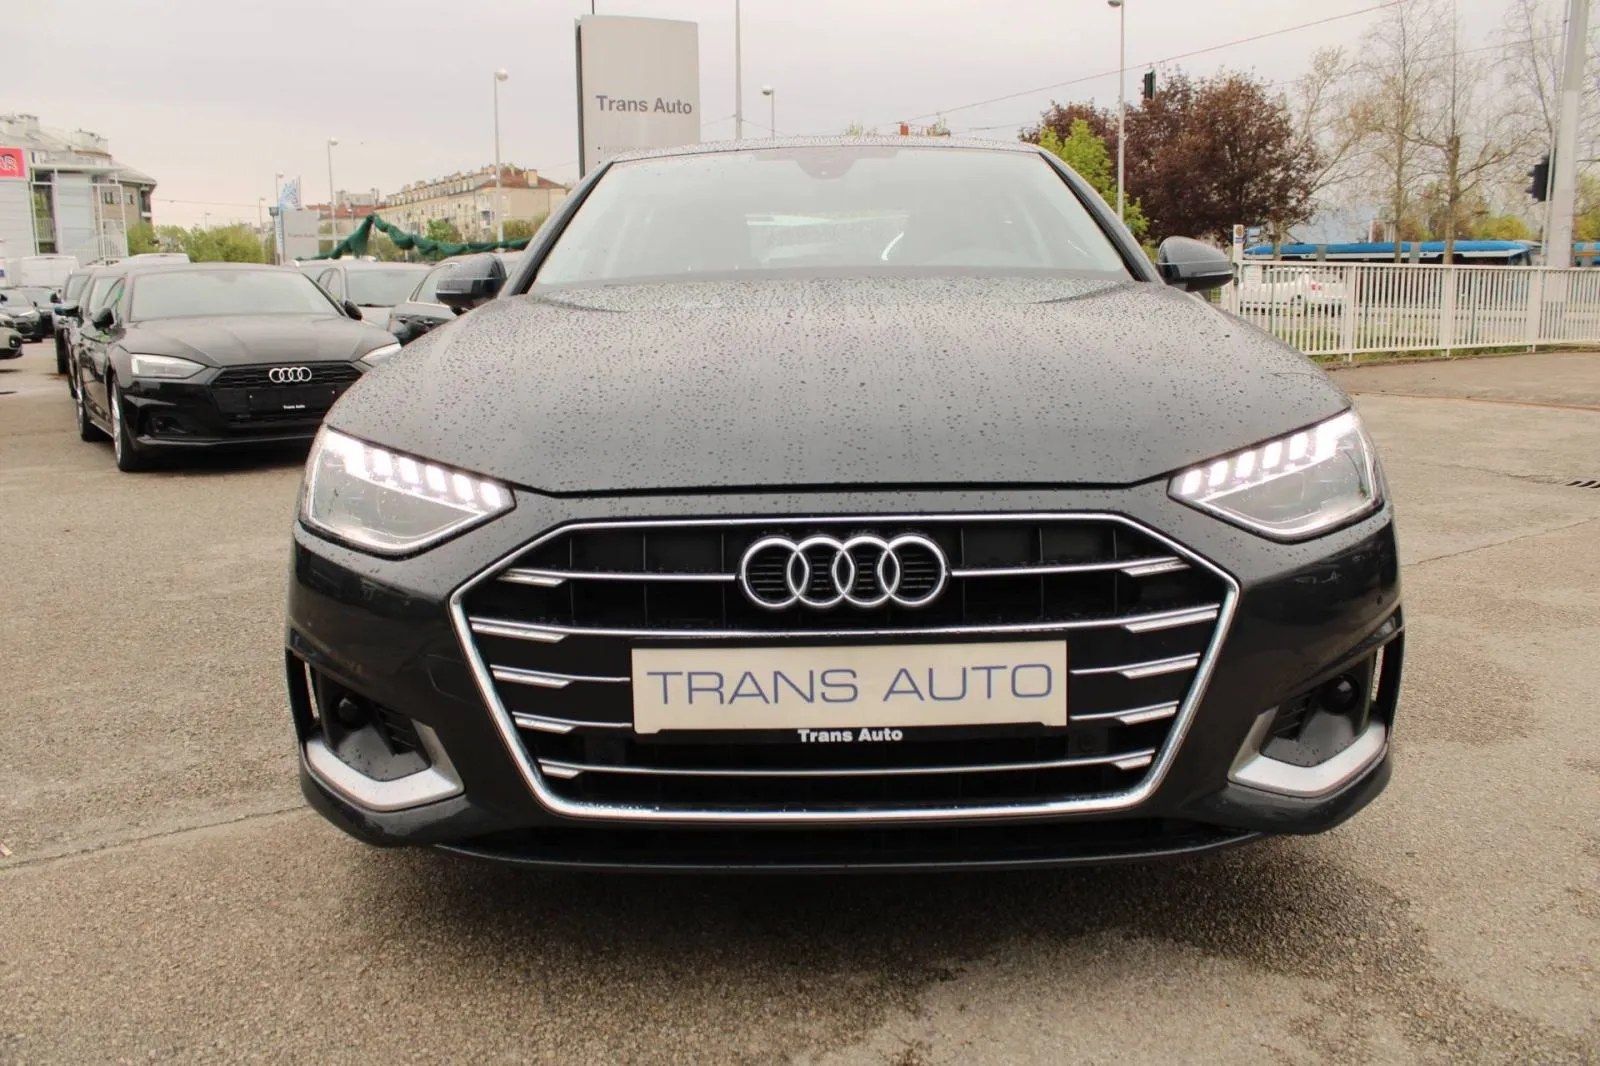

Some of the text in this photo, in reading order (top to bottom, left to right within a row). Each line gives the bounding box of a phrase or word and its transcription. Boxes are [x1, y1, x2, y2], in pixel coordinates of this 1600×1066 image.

[595, 95, 693, 115] Trans Auto
[647, 664, 1053, 704] TRANS AUTO
[797, 727, 903, 742] Trans Auto
